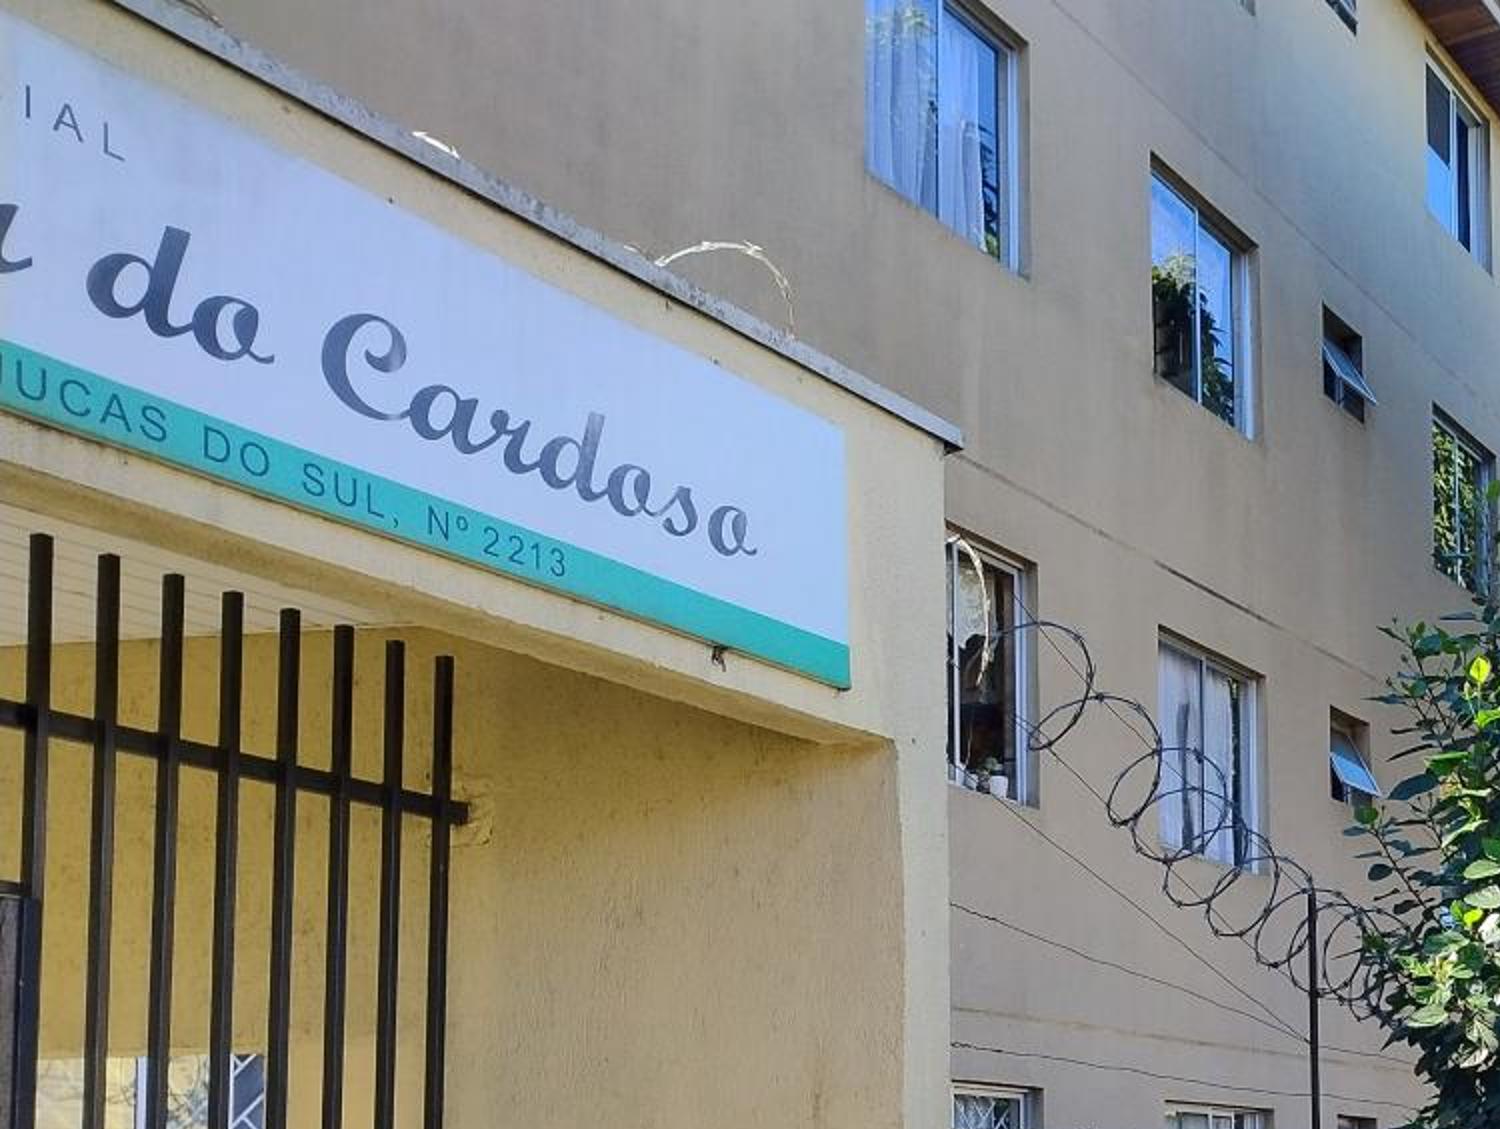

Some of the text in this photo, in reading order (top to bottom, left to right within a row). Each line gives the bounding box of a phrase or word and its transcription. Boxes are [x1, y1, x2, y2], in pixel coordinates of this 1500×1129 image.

[25, 85, 125, 162] IAL
[0, 353, 167, 442] UCAS
[203, 425, 270, 477] DO
[302, 462, 399, 528] SUL,
[483, 526, 566, 577] 2213
[86, 225, 758, 558] do Cardoso
